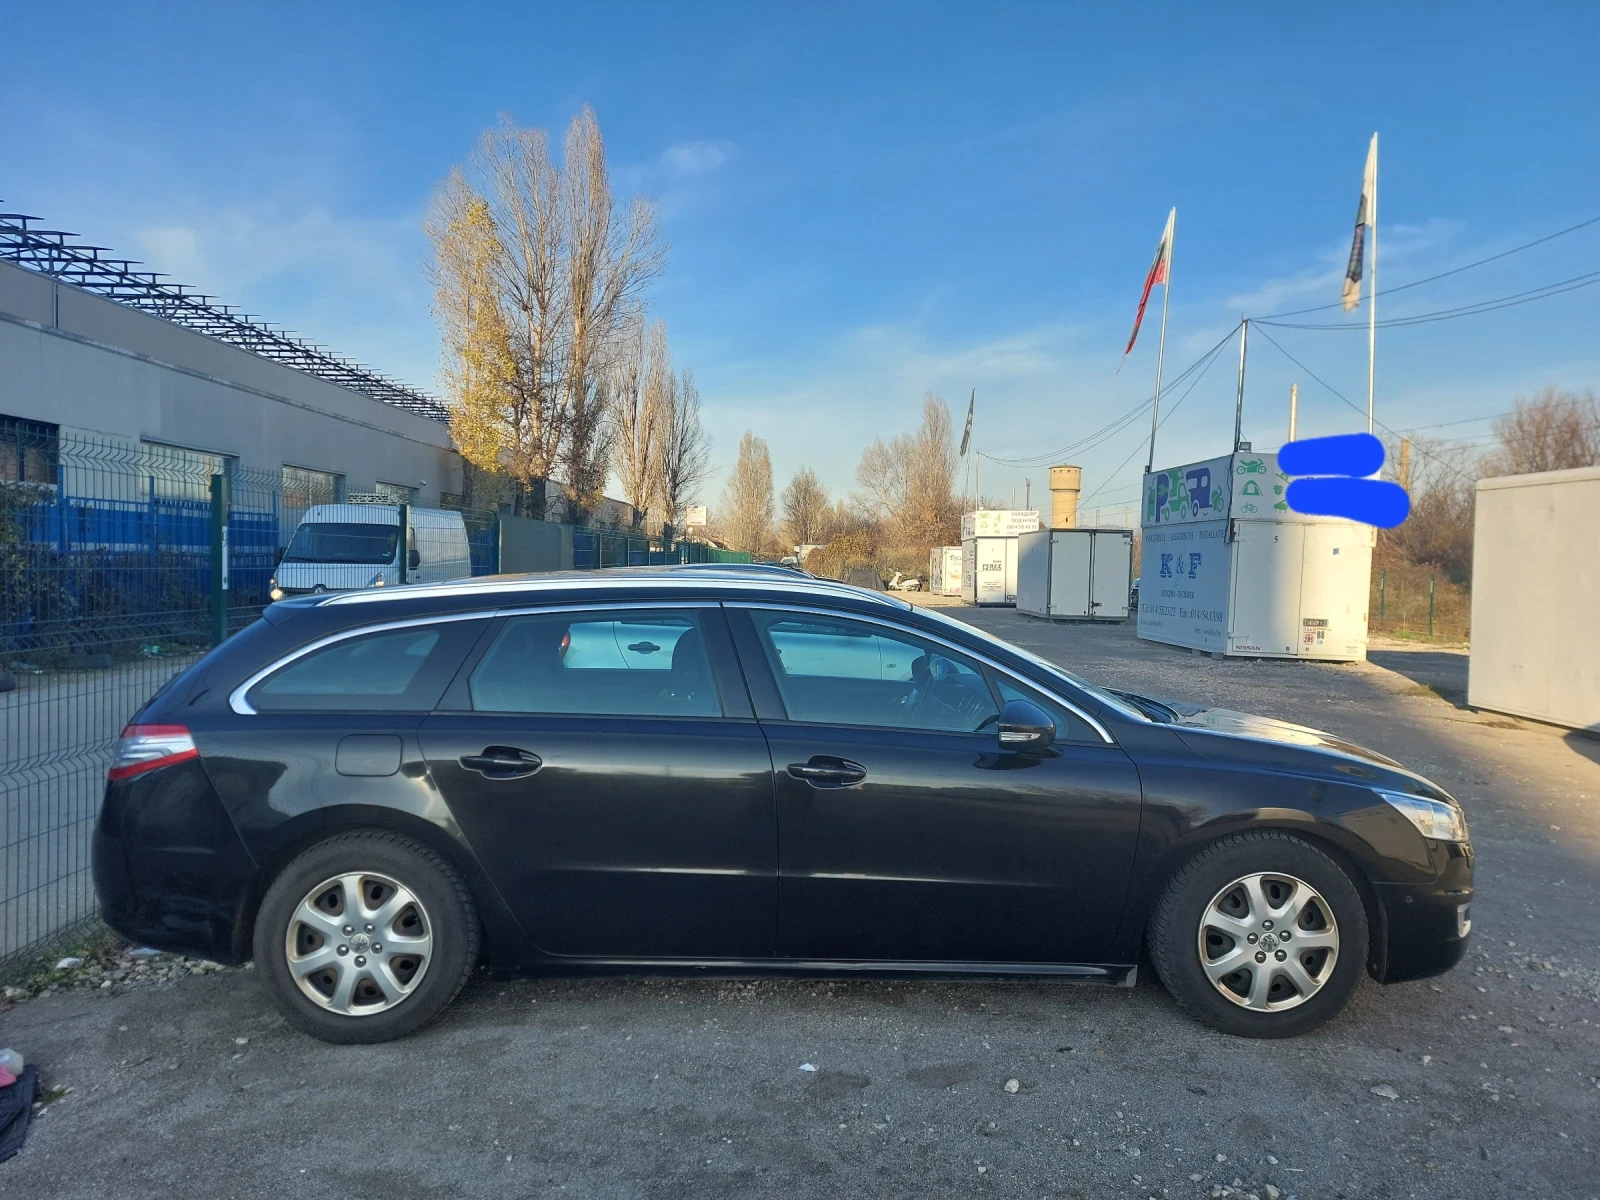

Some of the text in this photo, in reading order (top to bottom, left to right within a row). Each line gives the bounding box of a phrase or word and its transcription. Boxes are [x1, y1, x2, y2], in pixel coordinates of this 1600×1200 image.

[1273, 535, 1279, 544] 5
[1160, 552, 1202, 579] K & F
[1317, 630, 1325, 639] 88
